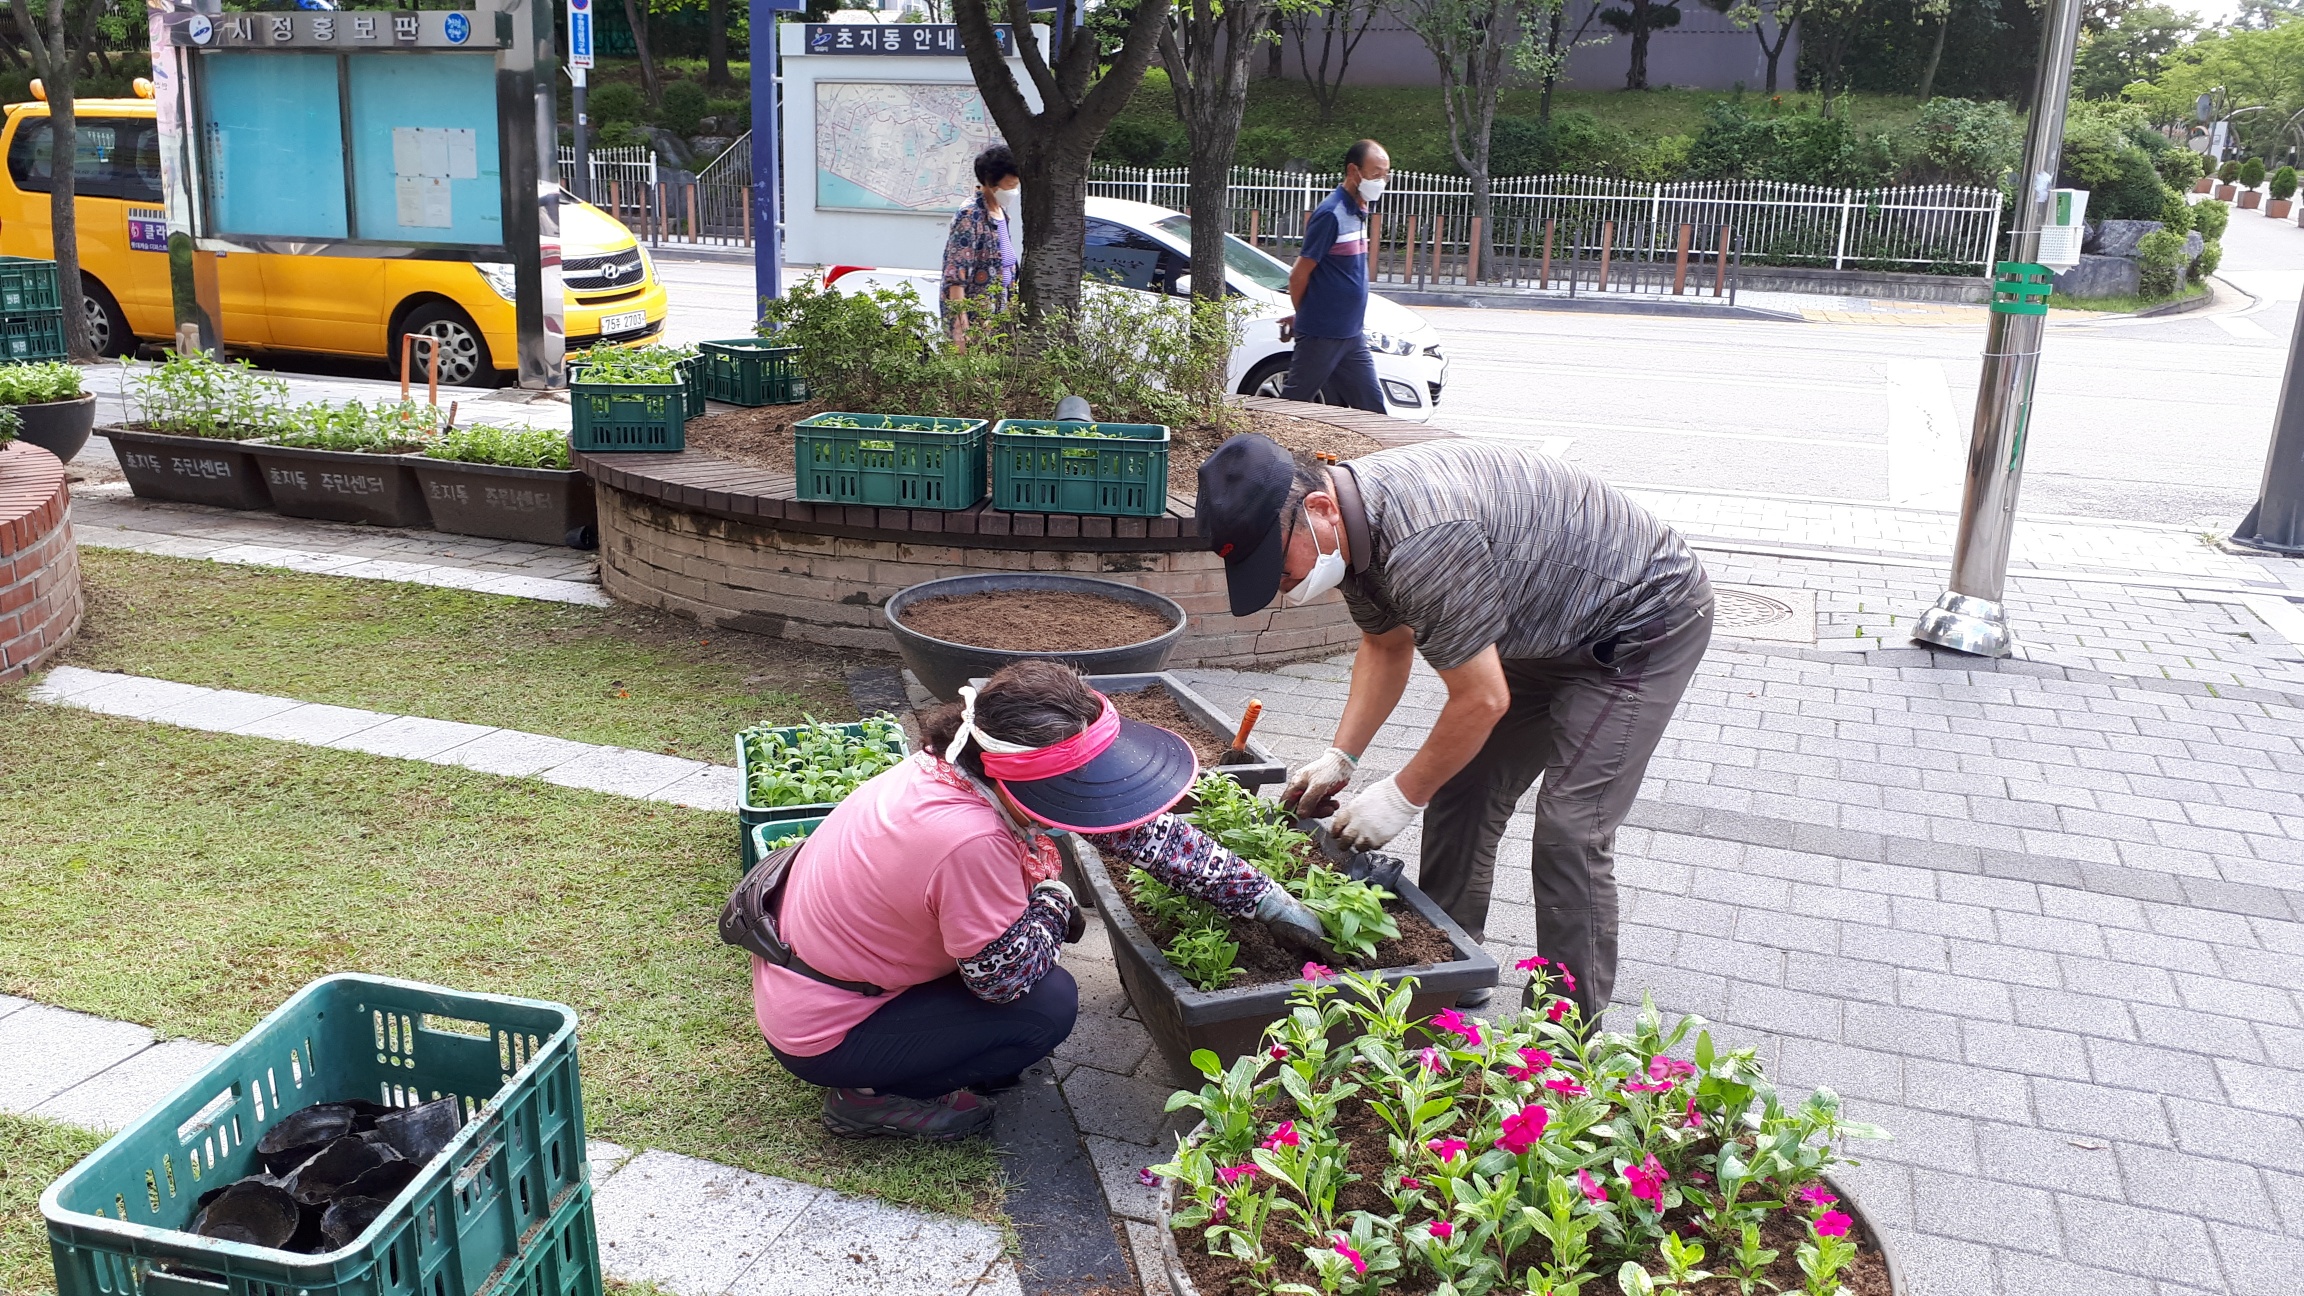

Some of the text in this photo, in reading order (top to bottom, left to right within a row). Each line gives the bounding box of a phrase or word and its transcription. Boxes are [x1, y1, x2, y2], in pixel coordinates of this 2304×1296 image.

[232, 17, 418, 41] 시정홍보판
[836, 28, 965, 51] 초지동 안내
[624, 314, 641, 327] 2703
[126, 451, 231, 479] 초지동 주민센터
[269, 467, 385, 495] 초지동 주민센터
[429, 481, 551, 511] 초지동 주민센터
